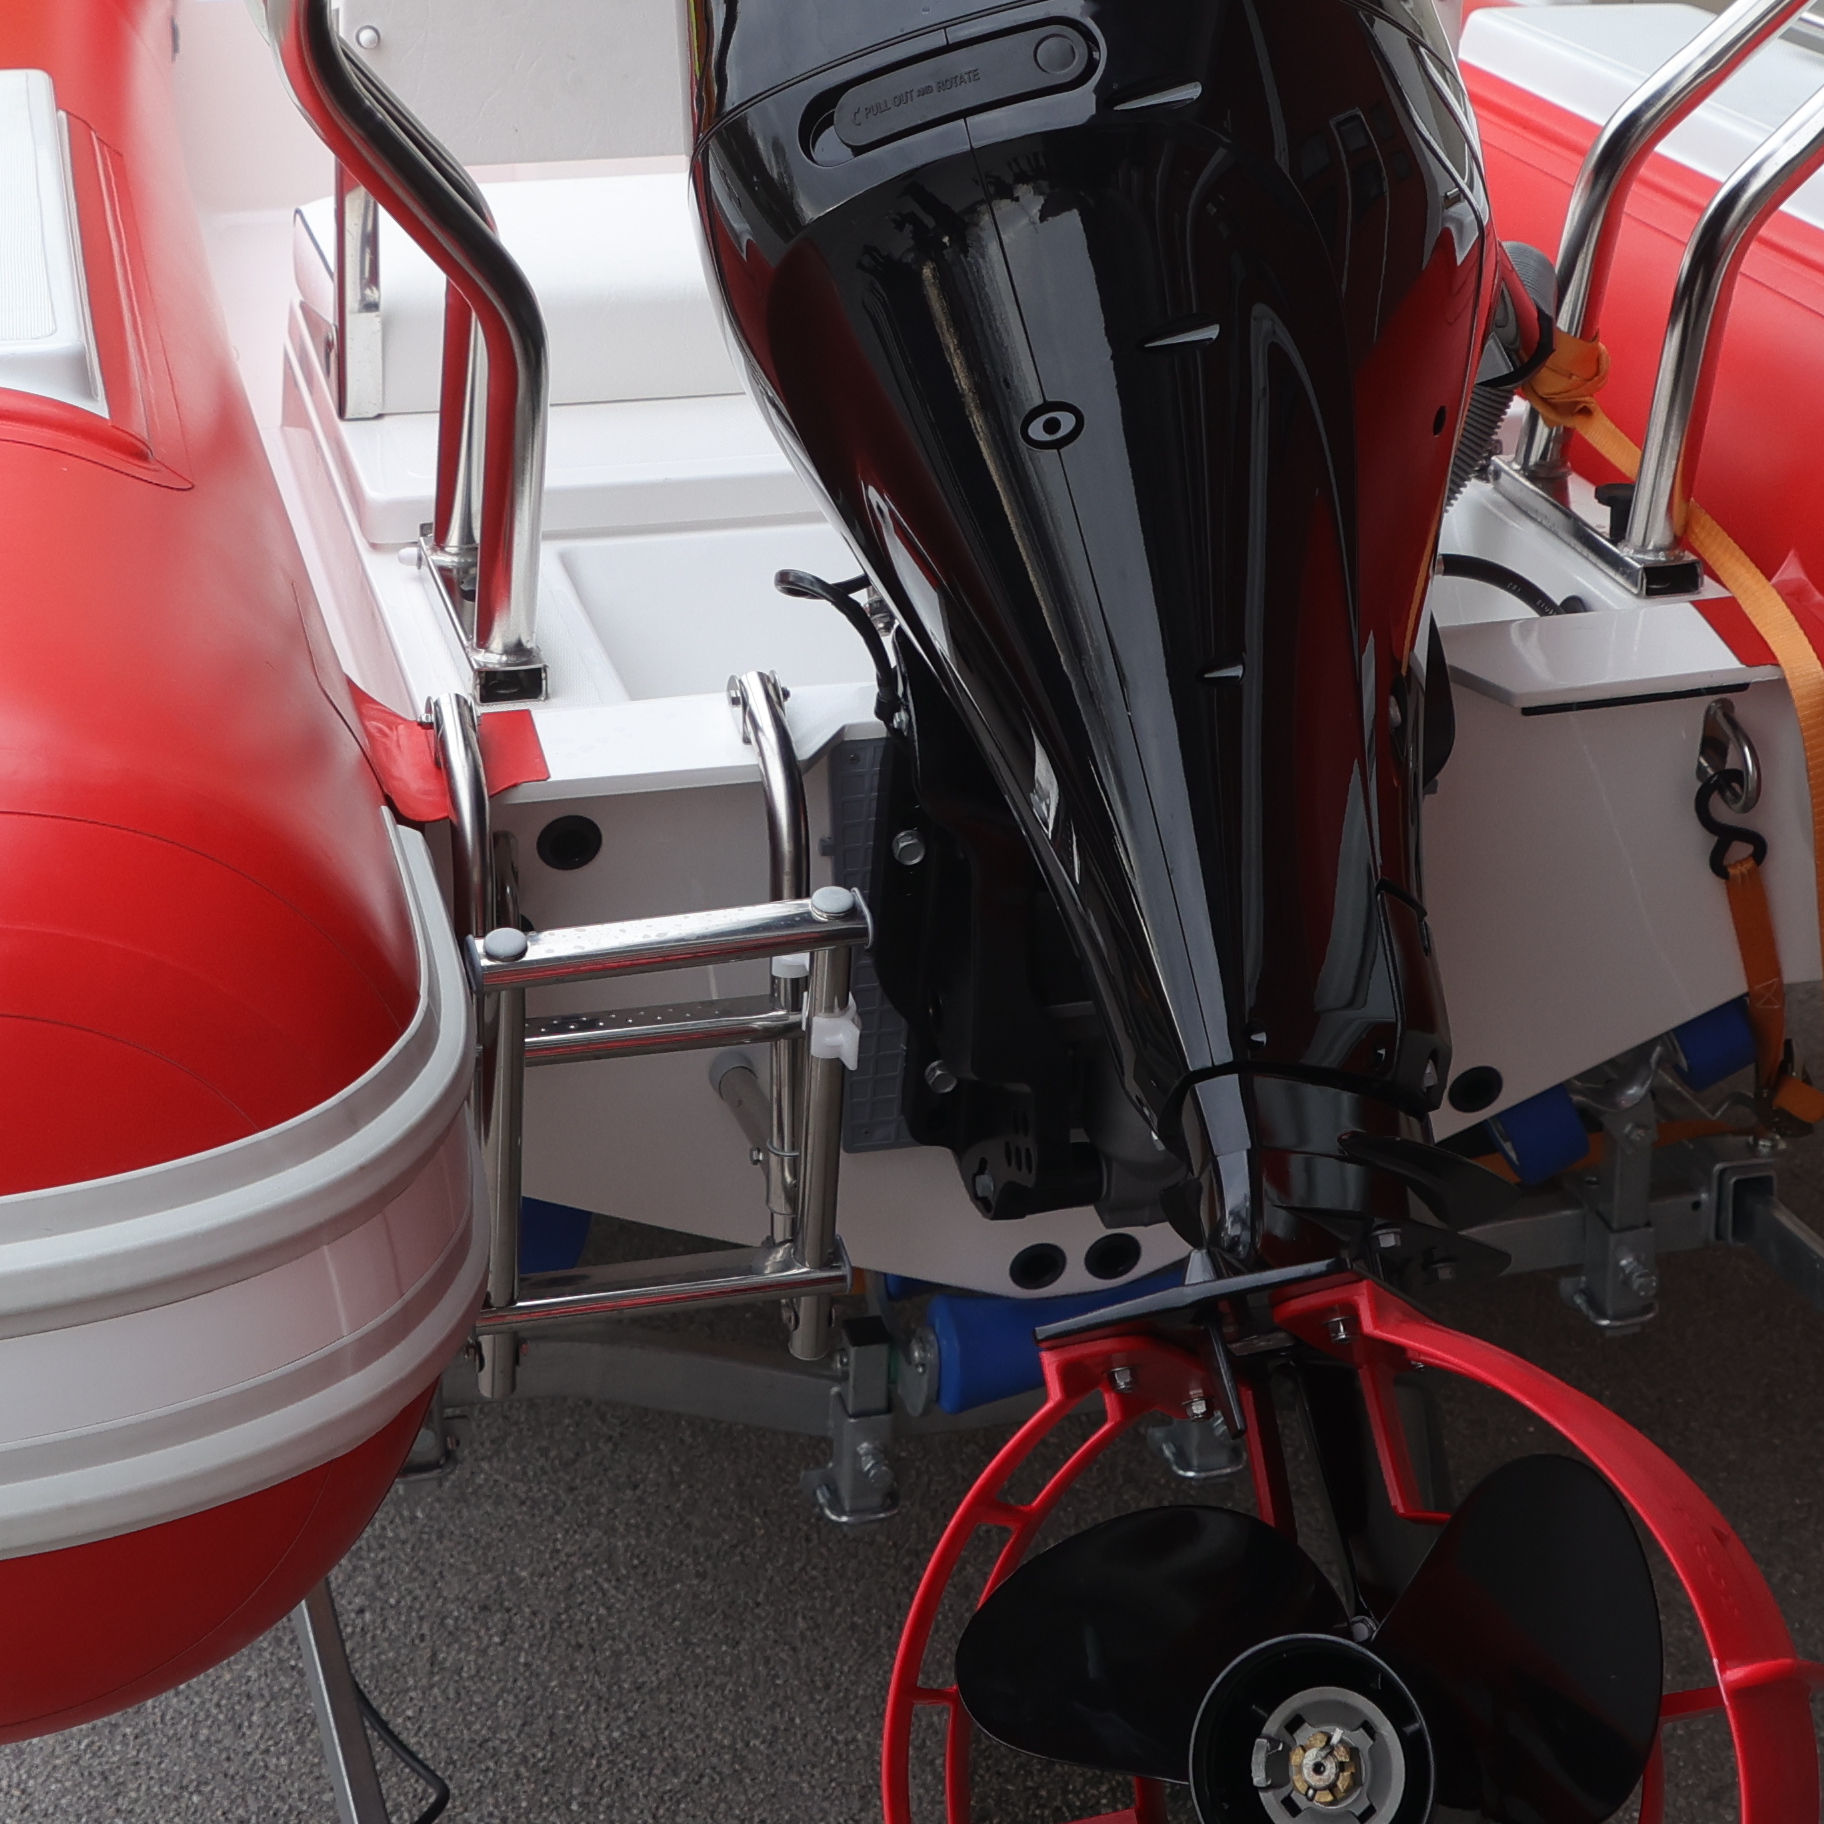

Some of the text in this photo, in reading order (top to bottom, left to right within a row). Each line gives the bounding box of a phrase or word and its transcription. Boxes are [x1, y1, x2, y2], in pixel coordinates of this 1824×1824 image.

[864, 99, 891, 119] PULL
[893, 88, 915, 108] OUT
[936, 69, 981, 94] ROTATE
